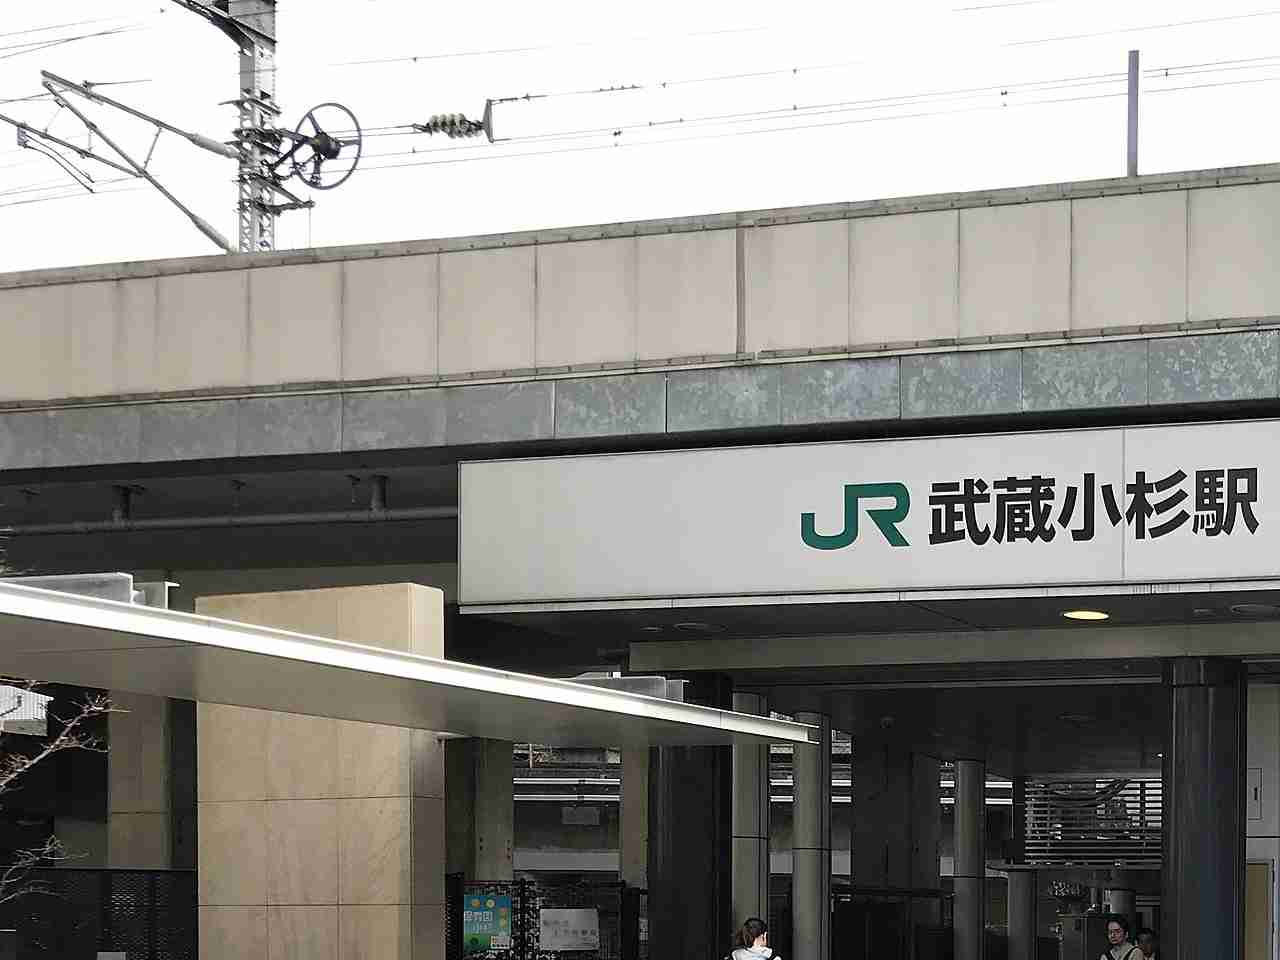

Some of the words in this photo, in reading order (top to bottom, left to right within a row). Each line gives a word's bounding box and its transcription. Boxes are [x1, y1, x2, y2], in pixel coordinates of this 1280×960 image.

[801, 483, 910, 550] JR
[929, 468, 1259, 545] 武蔵小杉駅
